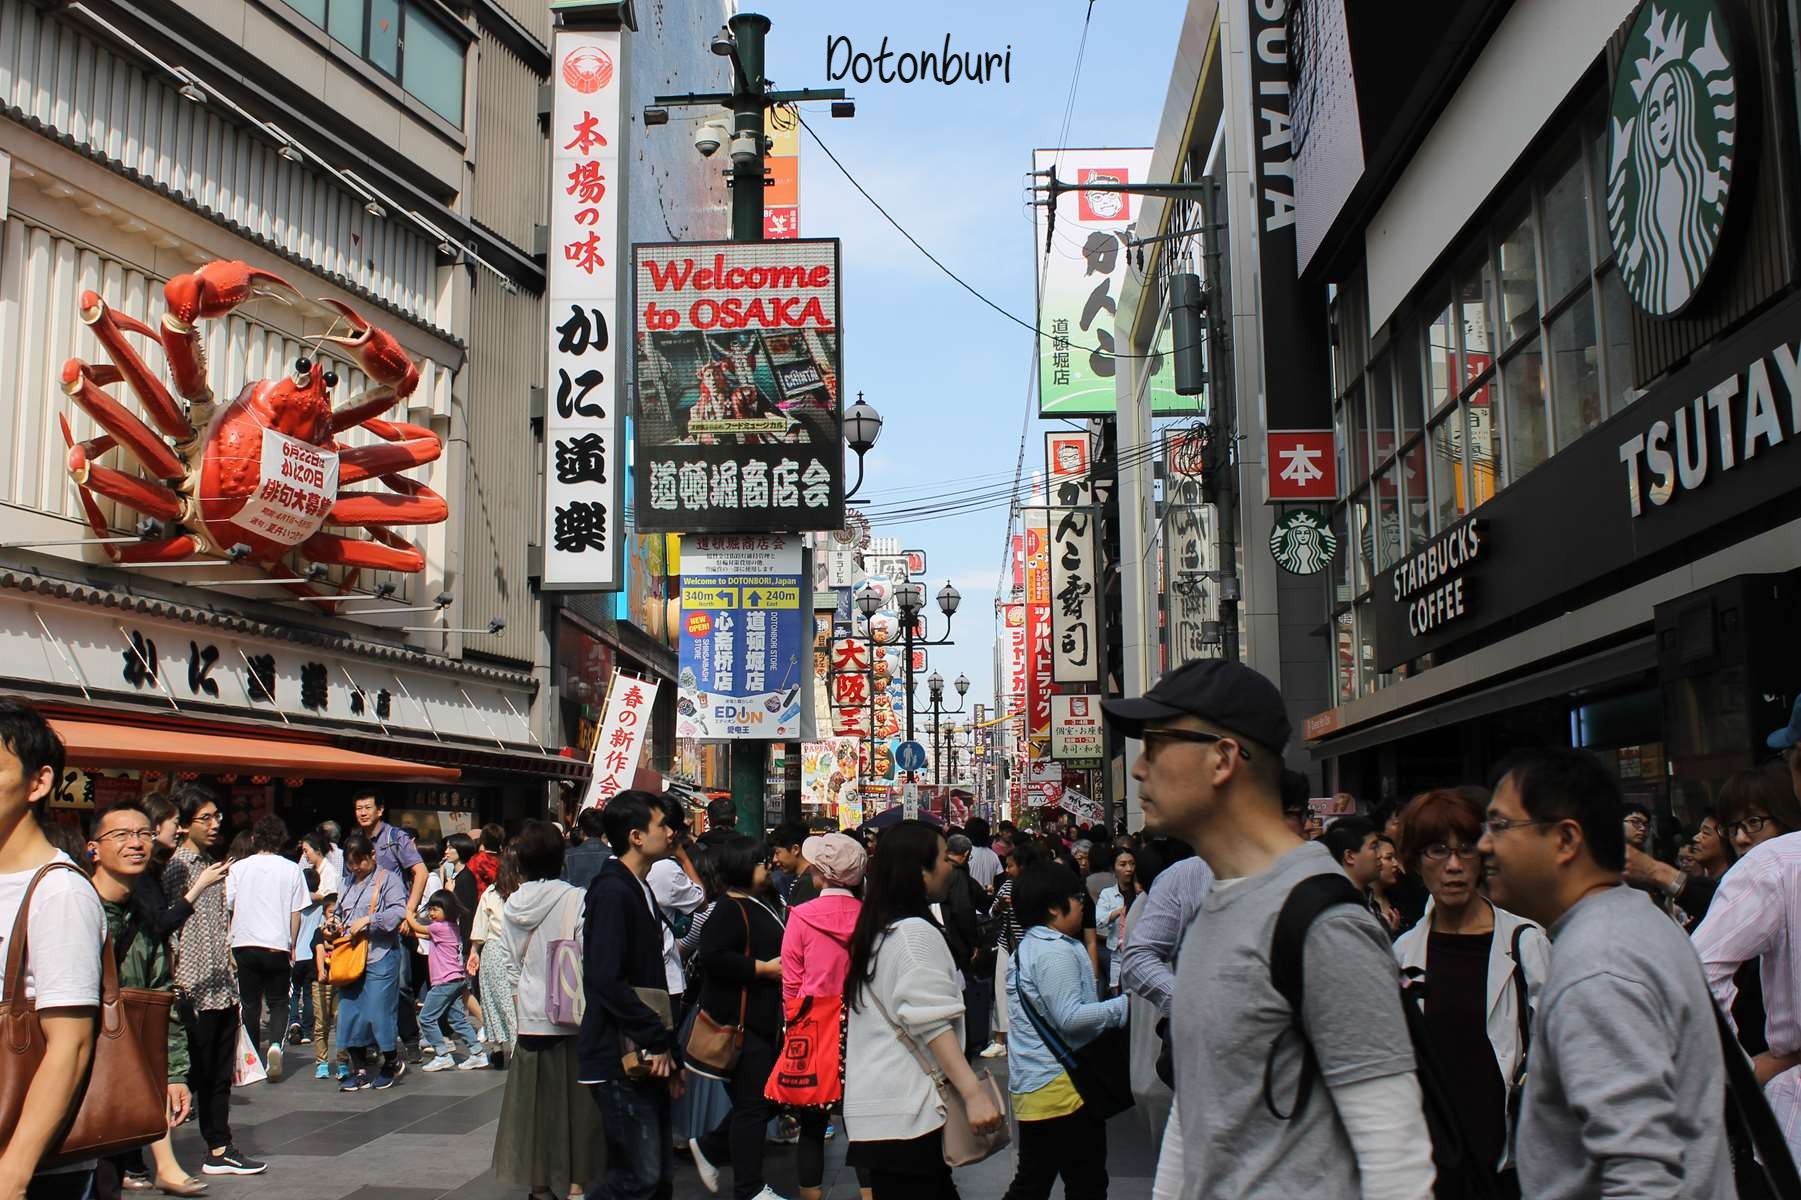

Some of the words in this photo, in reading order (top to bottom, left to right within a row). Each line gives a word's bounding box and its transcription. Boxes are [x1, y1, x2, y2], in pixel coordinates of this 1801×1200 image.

[564, 110, 608, 275] 本場の味
[642, 253, 831, 292] Welcome
[643, 302, 681, 331] to
[689, 296, 833, 330] OSAKA
[1051, 319, 1070, 386] 道頓堀店
[554, 304, 609, 553] かに道楽
[1619, 343, 1801, 518] TSUTAY
[281, 459, 324, 490] かにの日
[650, 457, 831, 510] 道頓堀商店会
[1278, 444, 1323, 487] 本
[261, 479, 333, 518] 俳句大募集
[1394, 518, 1478, 602] STARBUCKS
[684, 577, 717, 585] Welcome
[775, 577, 797, 586] Japan
[685, 590, 714, 601] 340m
[766, 590, 796, 601] 240m
[690, 616, 706, 624] NEW
[1409, 578, 1465, 637] COFFEE
[688, 622, 710, 634] OPEN!
[770, 611, 778, 648] DOTONBORI
[694, 638, 702, 660] STORE
[770, 649, 778, 672] STORE
[714, 705, 763, 724] EDION
